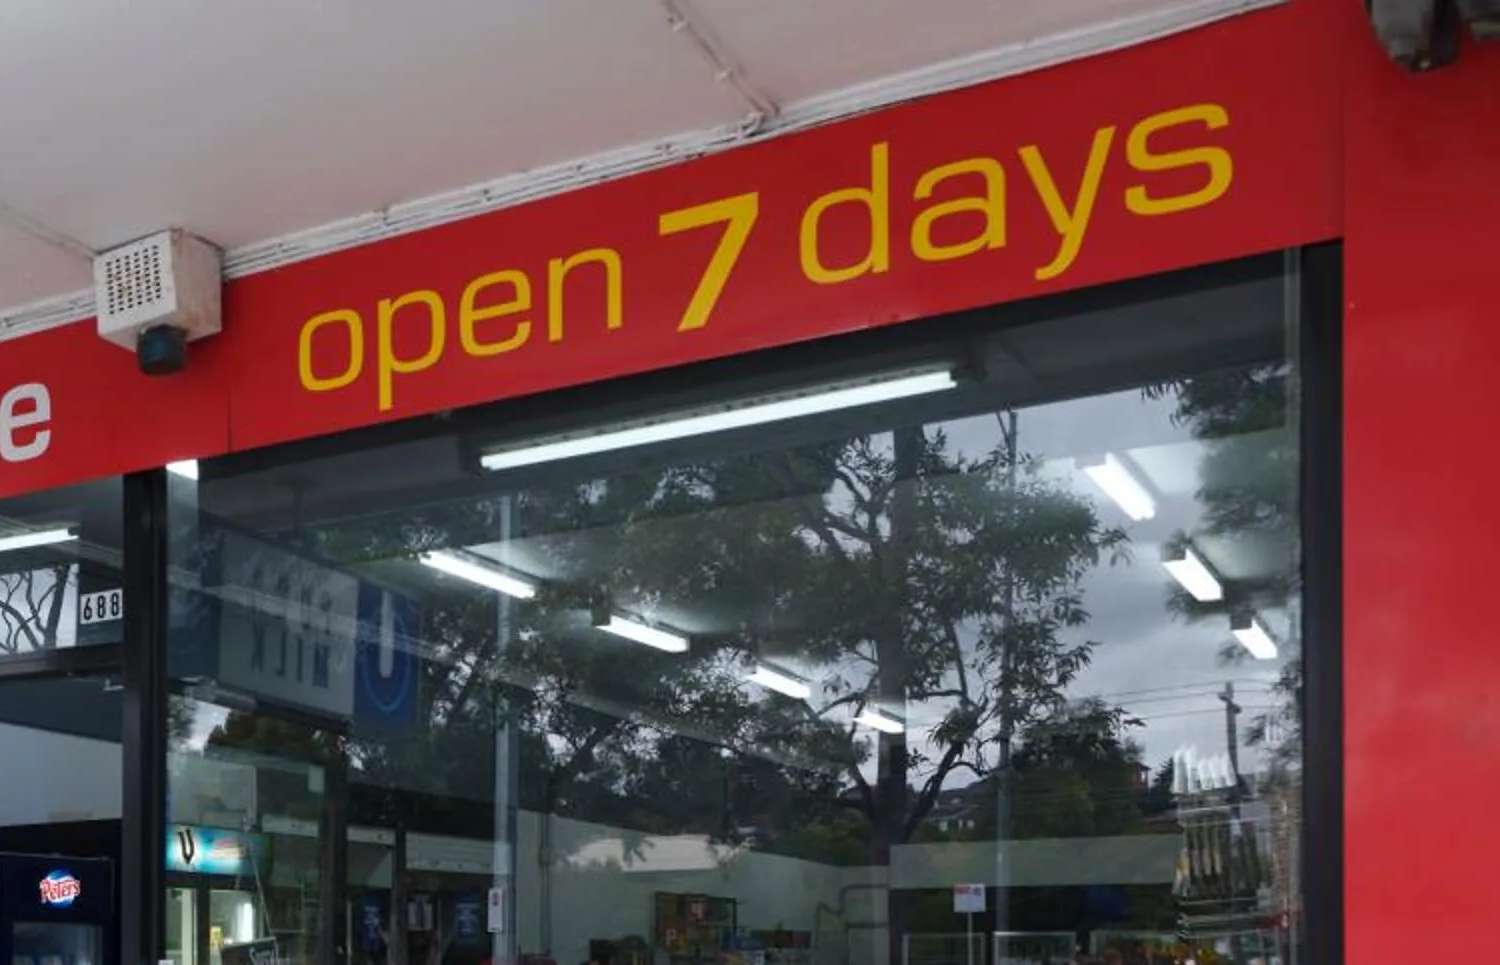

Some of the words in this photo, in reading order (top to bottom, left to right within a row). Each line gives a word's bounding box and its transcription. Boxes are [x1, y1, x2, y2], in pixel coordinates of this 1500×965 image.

[298, 248, 623, 411] open
[658, 191, 759, 332] 7
[799, 102, 1234, 284] days
[83, 592, 121, 621] 688
